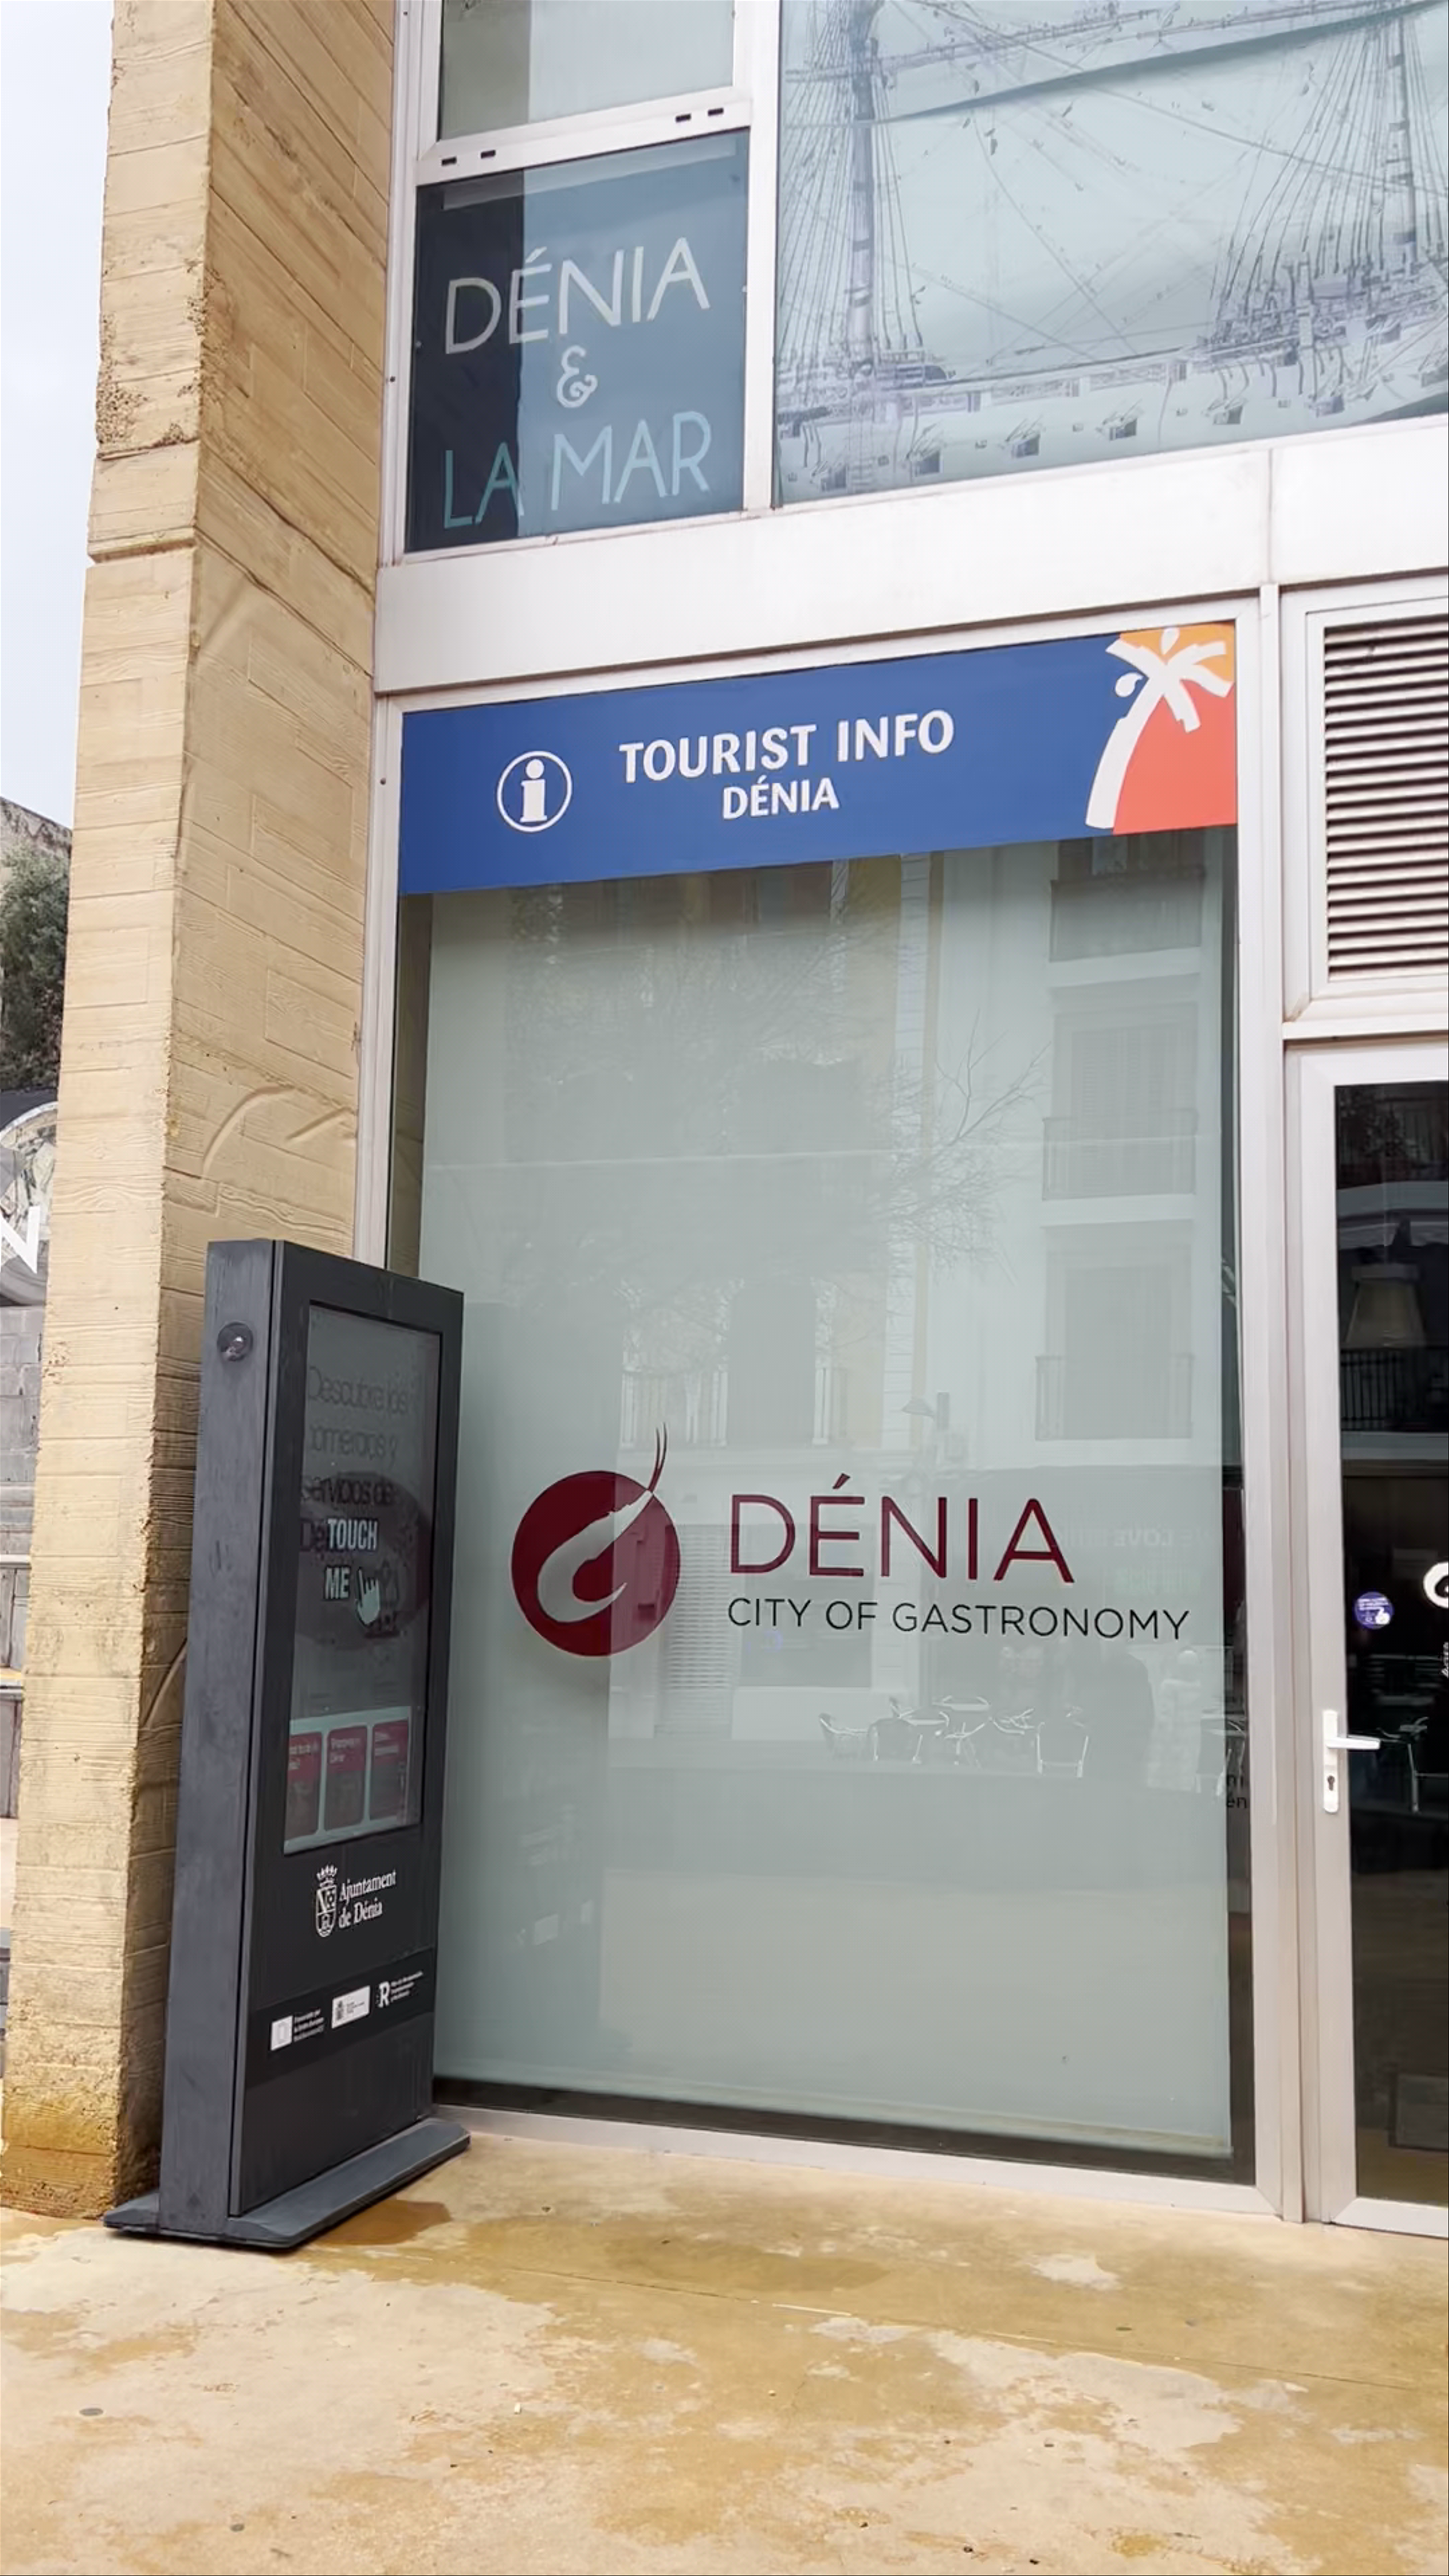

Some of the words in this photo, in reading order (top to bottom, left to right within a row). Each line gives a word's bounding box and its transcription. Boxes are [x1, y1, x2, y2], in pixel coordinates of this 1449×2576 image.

[446, 237, 710, 354] DÉNIA
[556, 345, 597, 408] &
[444, 442, 524, 528] LA
[551, 411, 711, 510] MAR
[619, 724, 817, 783] TOURIST
[837, 710, 955, 761] INFO
[723, 777, 839, 820] DÉNIA
[327, 1518, 378, 1551] TOUCH
[731, 1473, 1074, 1583] DÉNIA
[325, 1567, 350, 1599] ME
[728, 1598, 811, 1627] CITY
[826, 1601, 877, 1630] OF
[892, 1603, 1189, 1639] GASTRONOMY
[339, 1870, 396, 1905] Ajuntament
[339, 1907, 351, 1928] de
[354, 1896, 382, 1924] Dénia
